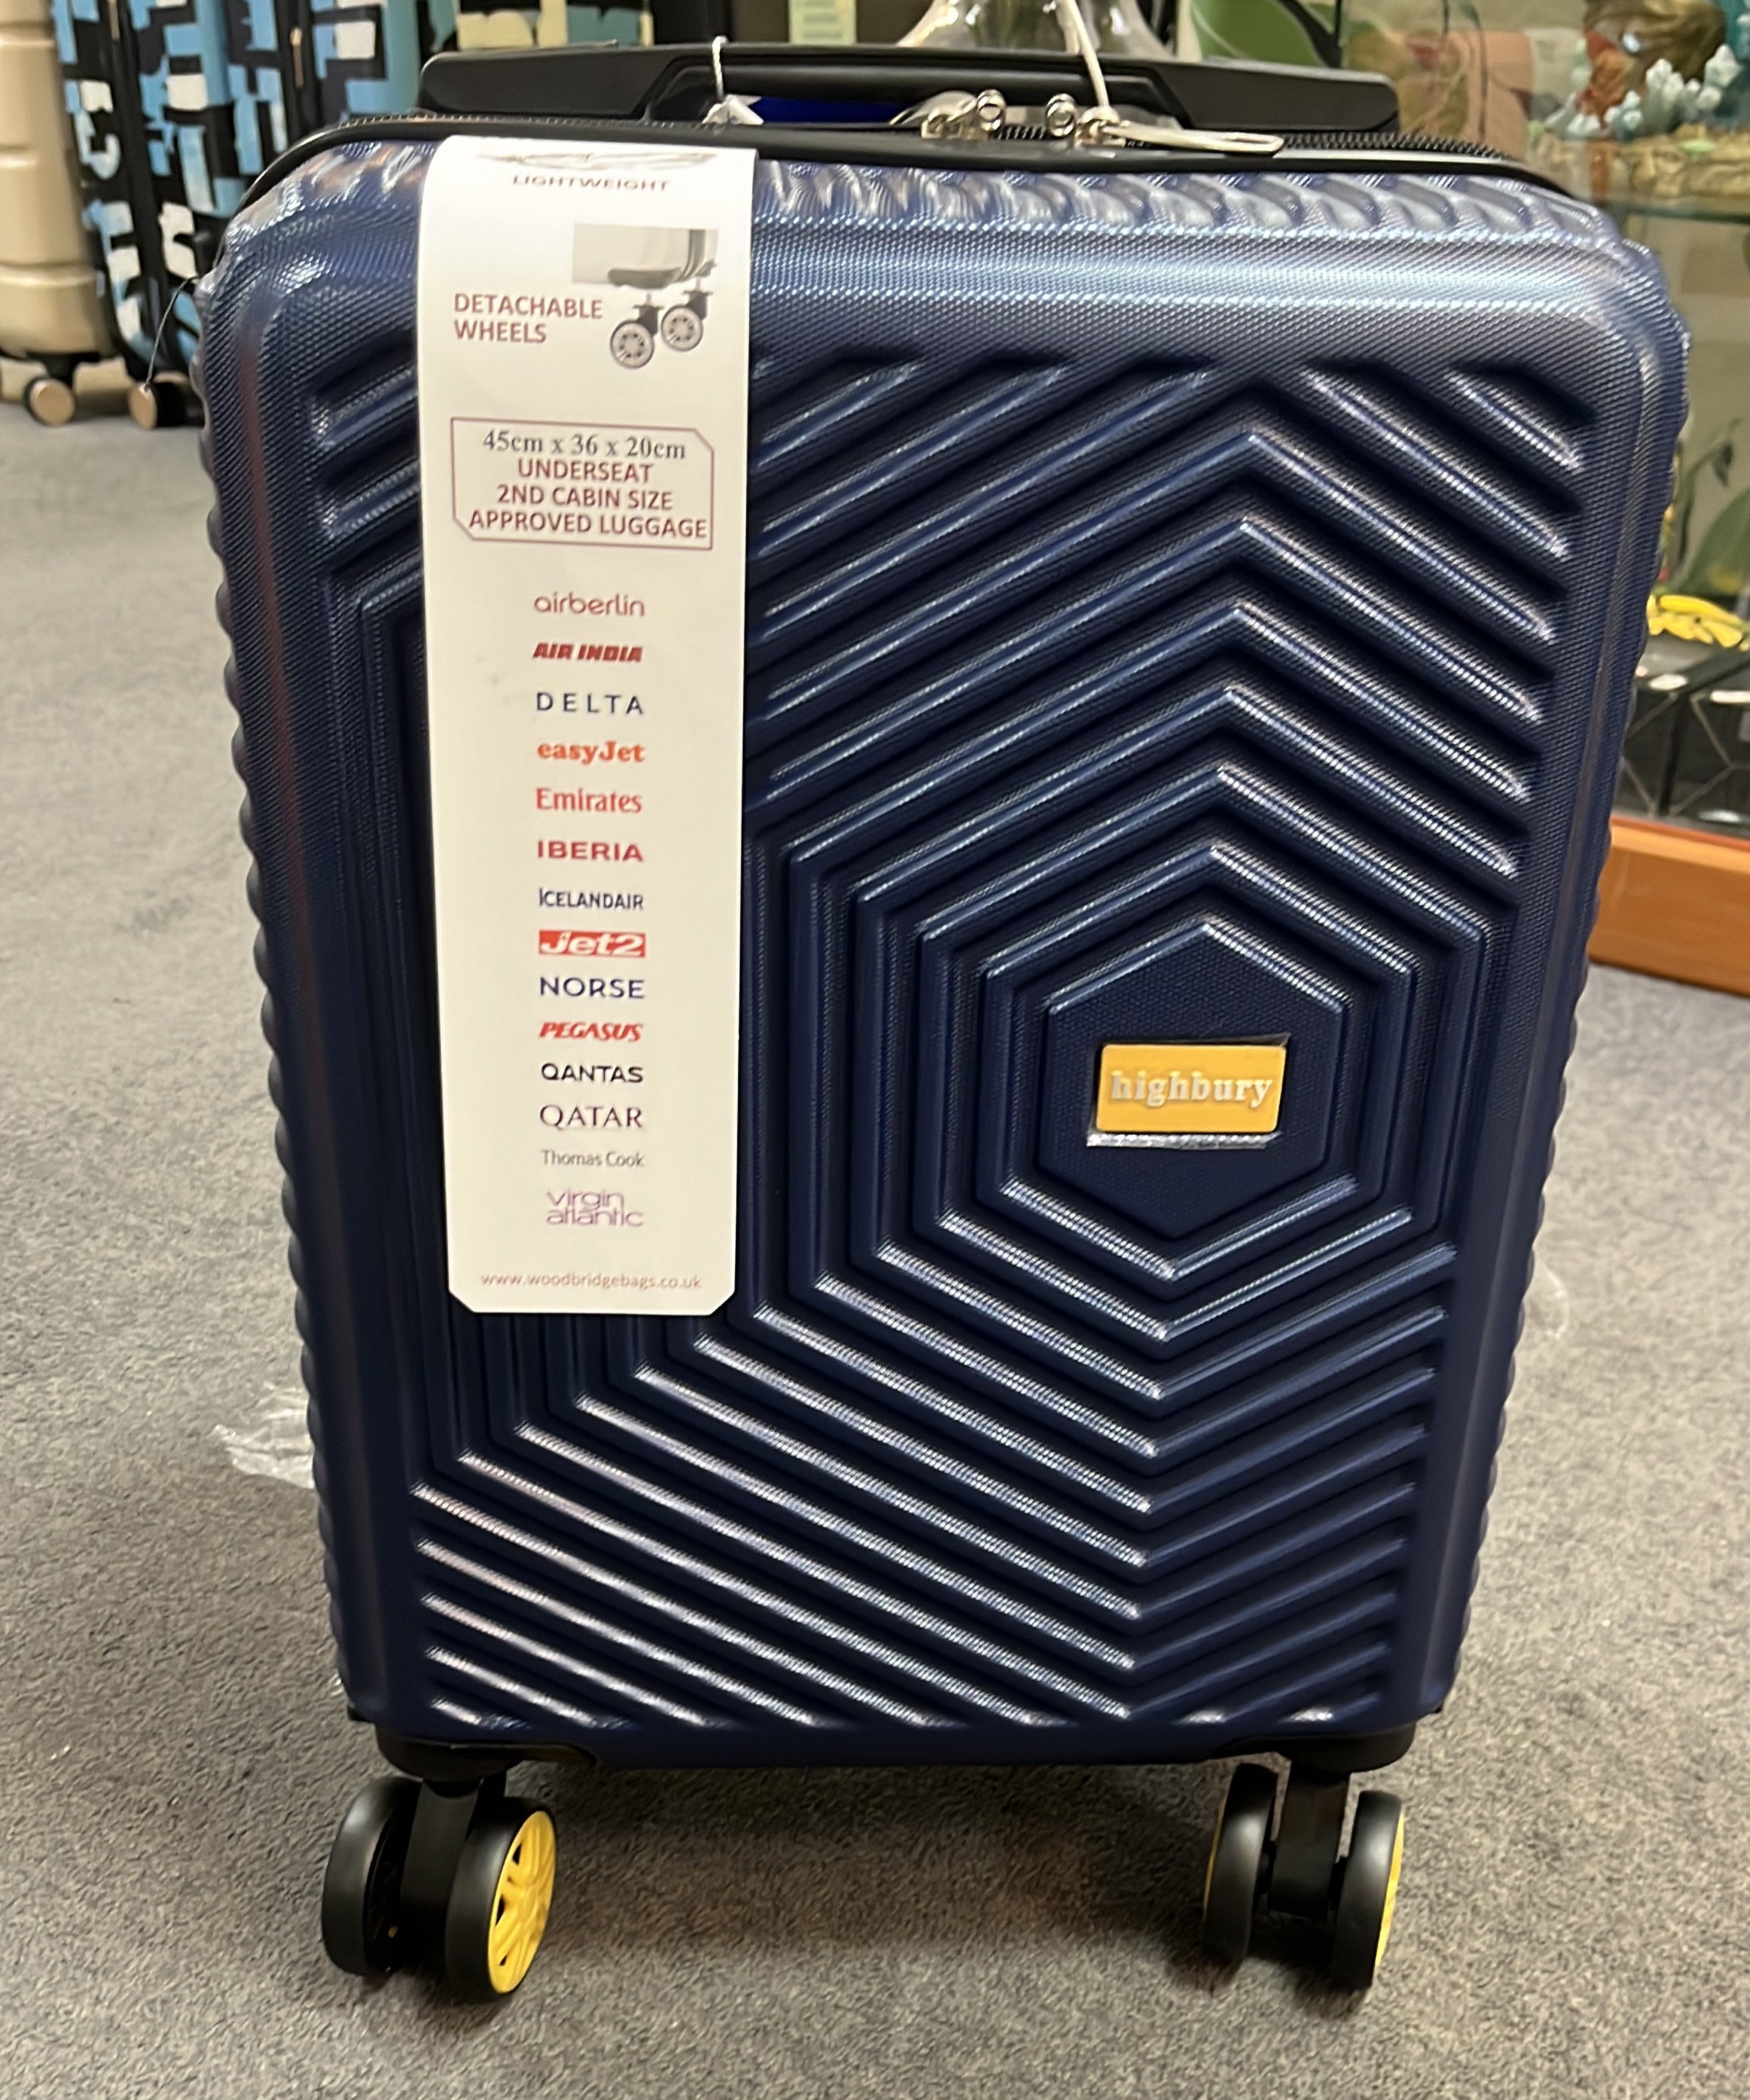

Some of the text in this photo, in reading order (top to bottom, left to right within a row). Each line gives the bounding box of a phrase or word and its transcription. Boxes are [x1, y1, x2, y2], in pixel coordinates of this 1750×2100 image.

[513, 175, 670, 192] LIGHTWEIGHT
[454, 293, 603, 318] DETACHABLE
[454, 321, 546, 344] WHEELS
[483, 430, 686, 459] 45cm x 36 x 20cm
[518, 459, 654, 483] UNDERSEAT
[497, 484, 674, 510] 2ND CABIN SIZE
[469, 510, 707, 538] APPROVED LUGGAGE
[534, 591, 645, 617] airberlin
[533, 642, 643, 662] AIR INDIA
[536, 692, 644, 714] DELTA
[537, 740, 645, 765] easyJet
[536, 788, 642, 813] Emirates
[538, 840, 644, 861] IBERIA
[539, 887, 644, 910] ICELANDAIR
[539, 976, 645, 999] NORSE
[539, 1022, 644, 1042] PEGASUS
[540, 1063, 643, 1083] QANTAS
[1111, 1070, 1273, 1108] highbury
[539, 1104, 643, 1130] QATAR
[541, 1149, 645, 1168] Thomas Cook
[546, 1189, 625, 1212] virgin
[546, 1208, 645, 1227] atlantic
[481, 1274, 702, 1290] www.woodbridgebags.co.uk
